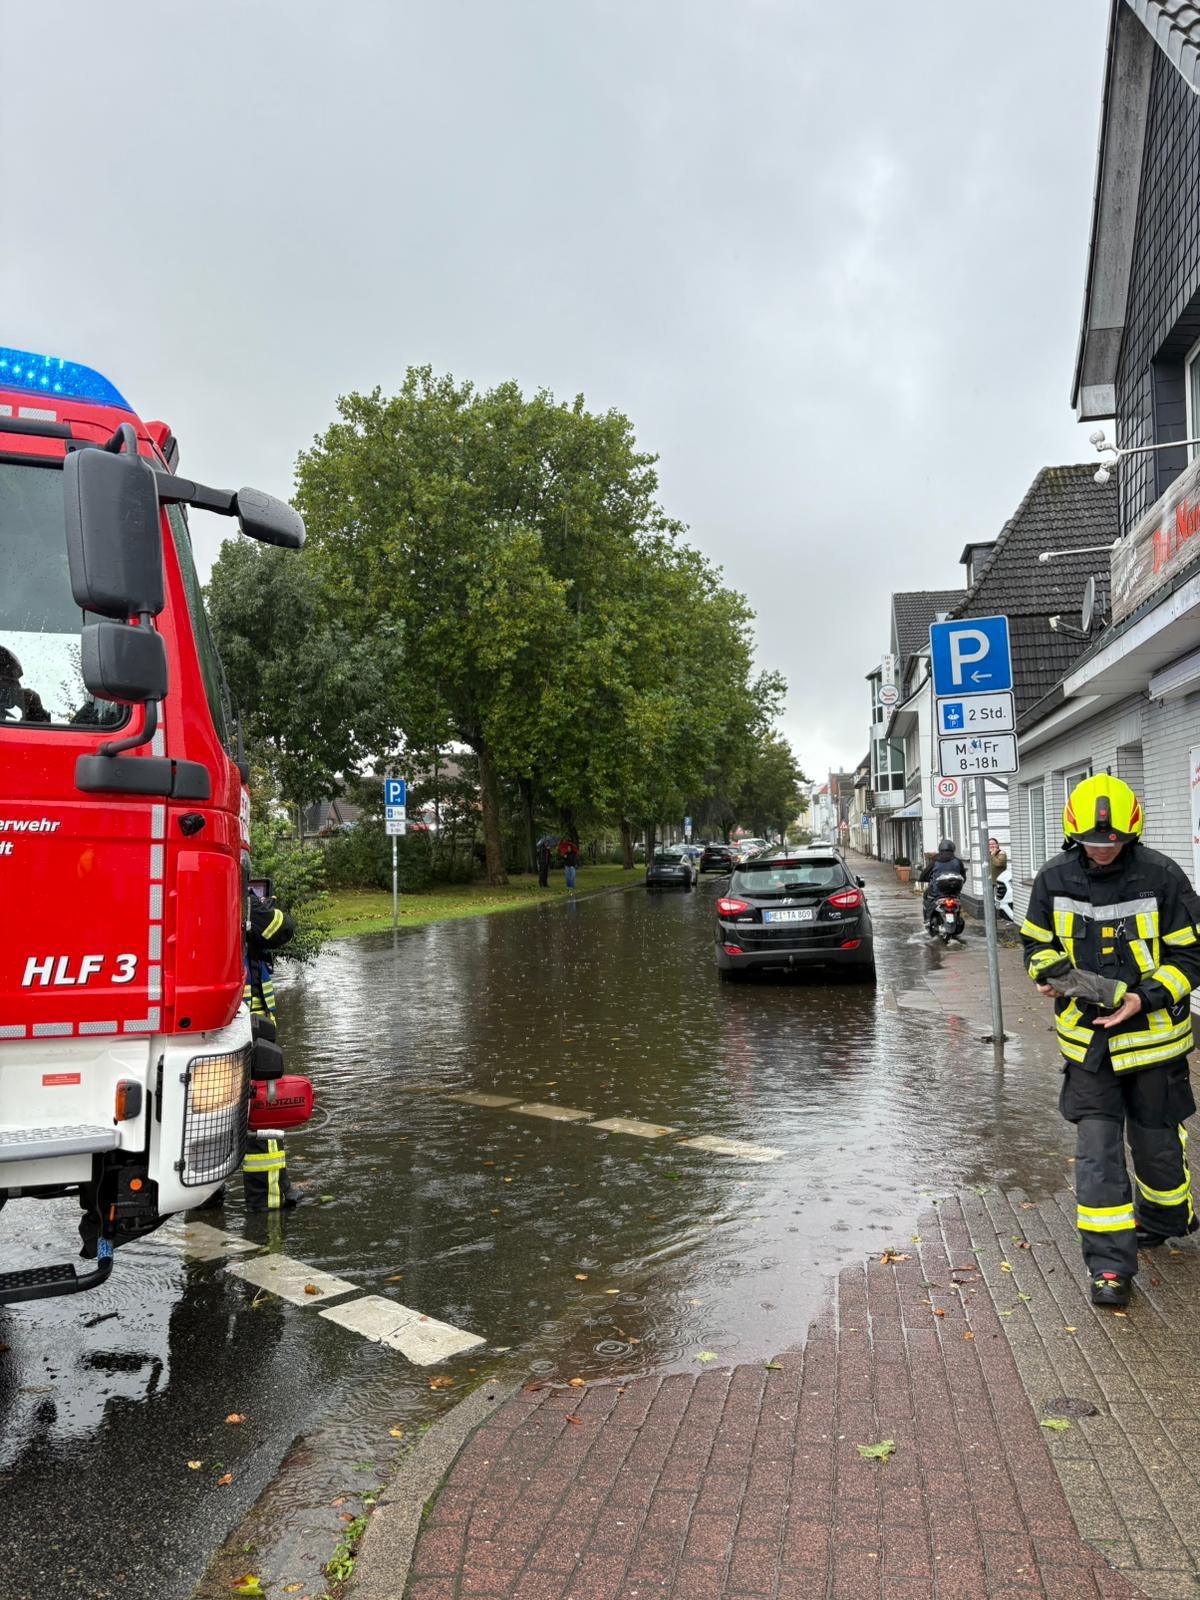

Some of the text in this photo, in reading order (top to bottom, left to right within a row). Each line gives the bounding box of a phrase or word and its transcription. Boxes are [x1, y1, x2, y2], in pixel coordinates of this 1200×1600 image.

[949, 629, 990, 686] P
[968, 707, 1007, 721] 2 Std.
[955, 741, 999, 756] MFr
[390, 782, 401, 803] P
[942, 783, 954, 792] 30
[787, 911, 797, 920] TA
[798, 909, 811, 919] 809
[21, 953, 138, 987] HLF 3
